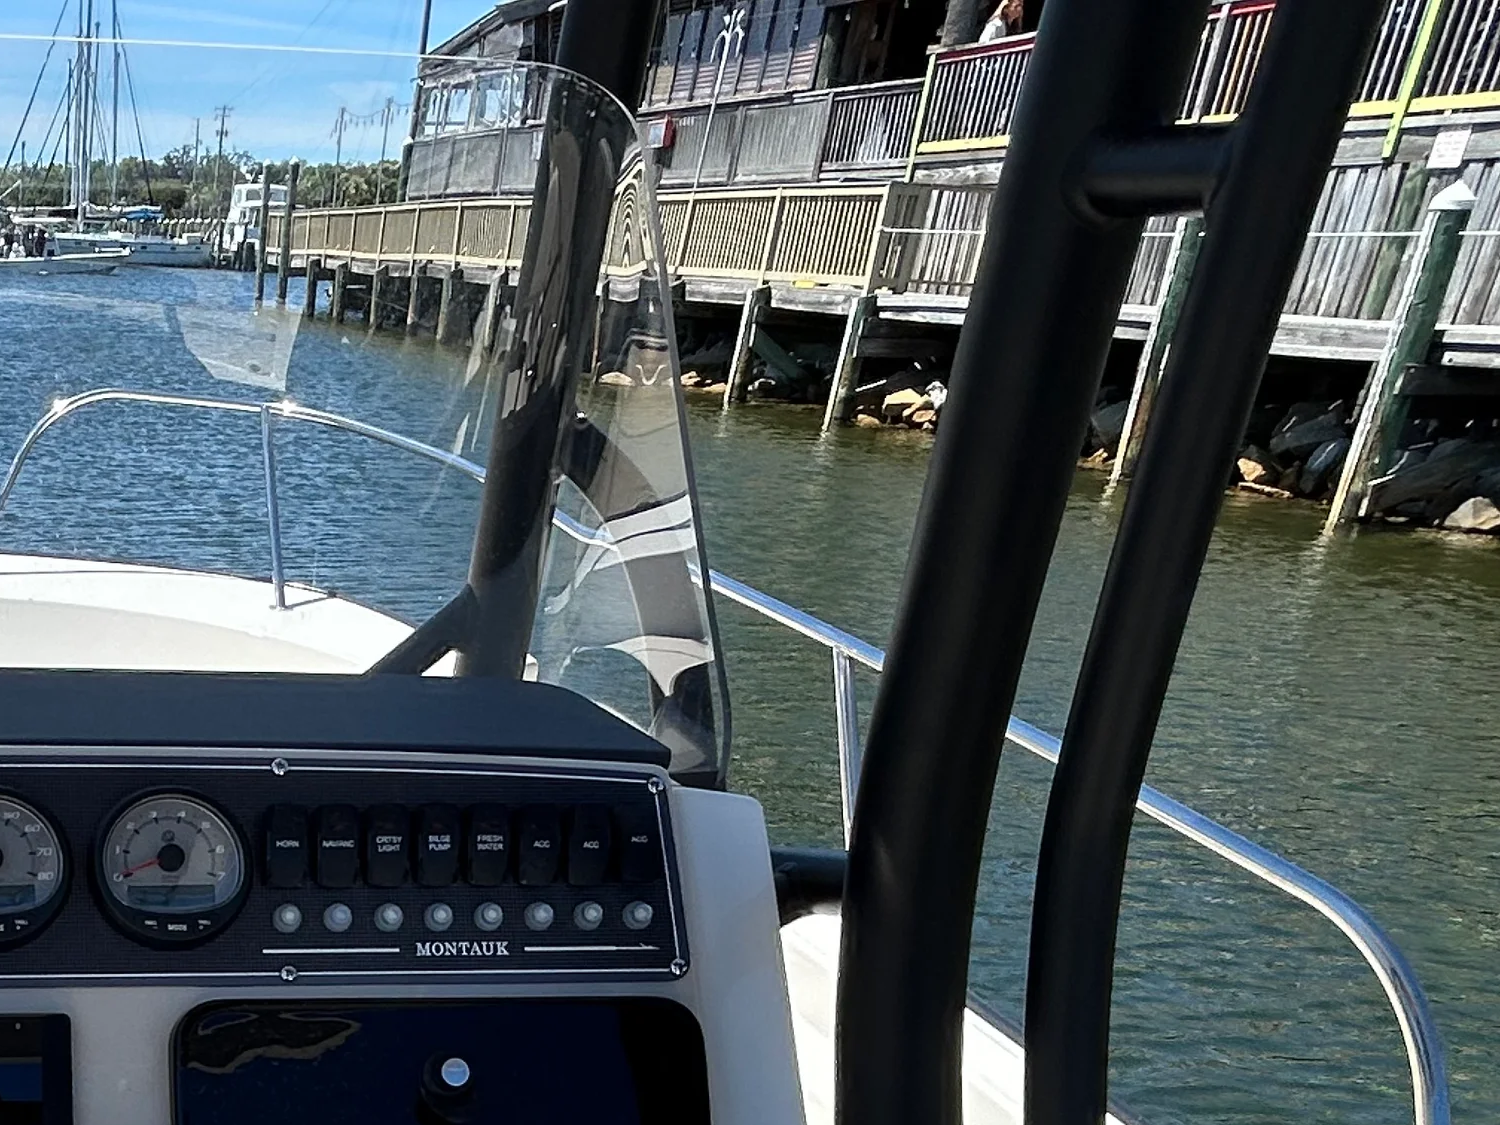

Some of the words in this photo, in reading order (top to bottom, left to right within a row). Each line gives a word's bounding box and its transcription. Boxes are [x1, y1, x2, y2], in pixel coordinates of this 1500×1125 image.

[4, 812, 20, 820] 50
[24, 825, 41, 833] 60
[477, 834, 503, 842] FRESH
[276, 840, 299, 848] HORN
[378, 844, 401, 852] LIGHT
[428, 842, 451, 851] PUMP
[477, 842, 504, 851] WATER
[533, 840, 550, 848] ACC
[583, 840, 599, 849] ACC
[36, 848, 52, 857] 70
[37, 872, 54, 881] 80
[415, 941, 509, 956] MONTAUK
